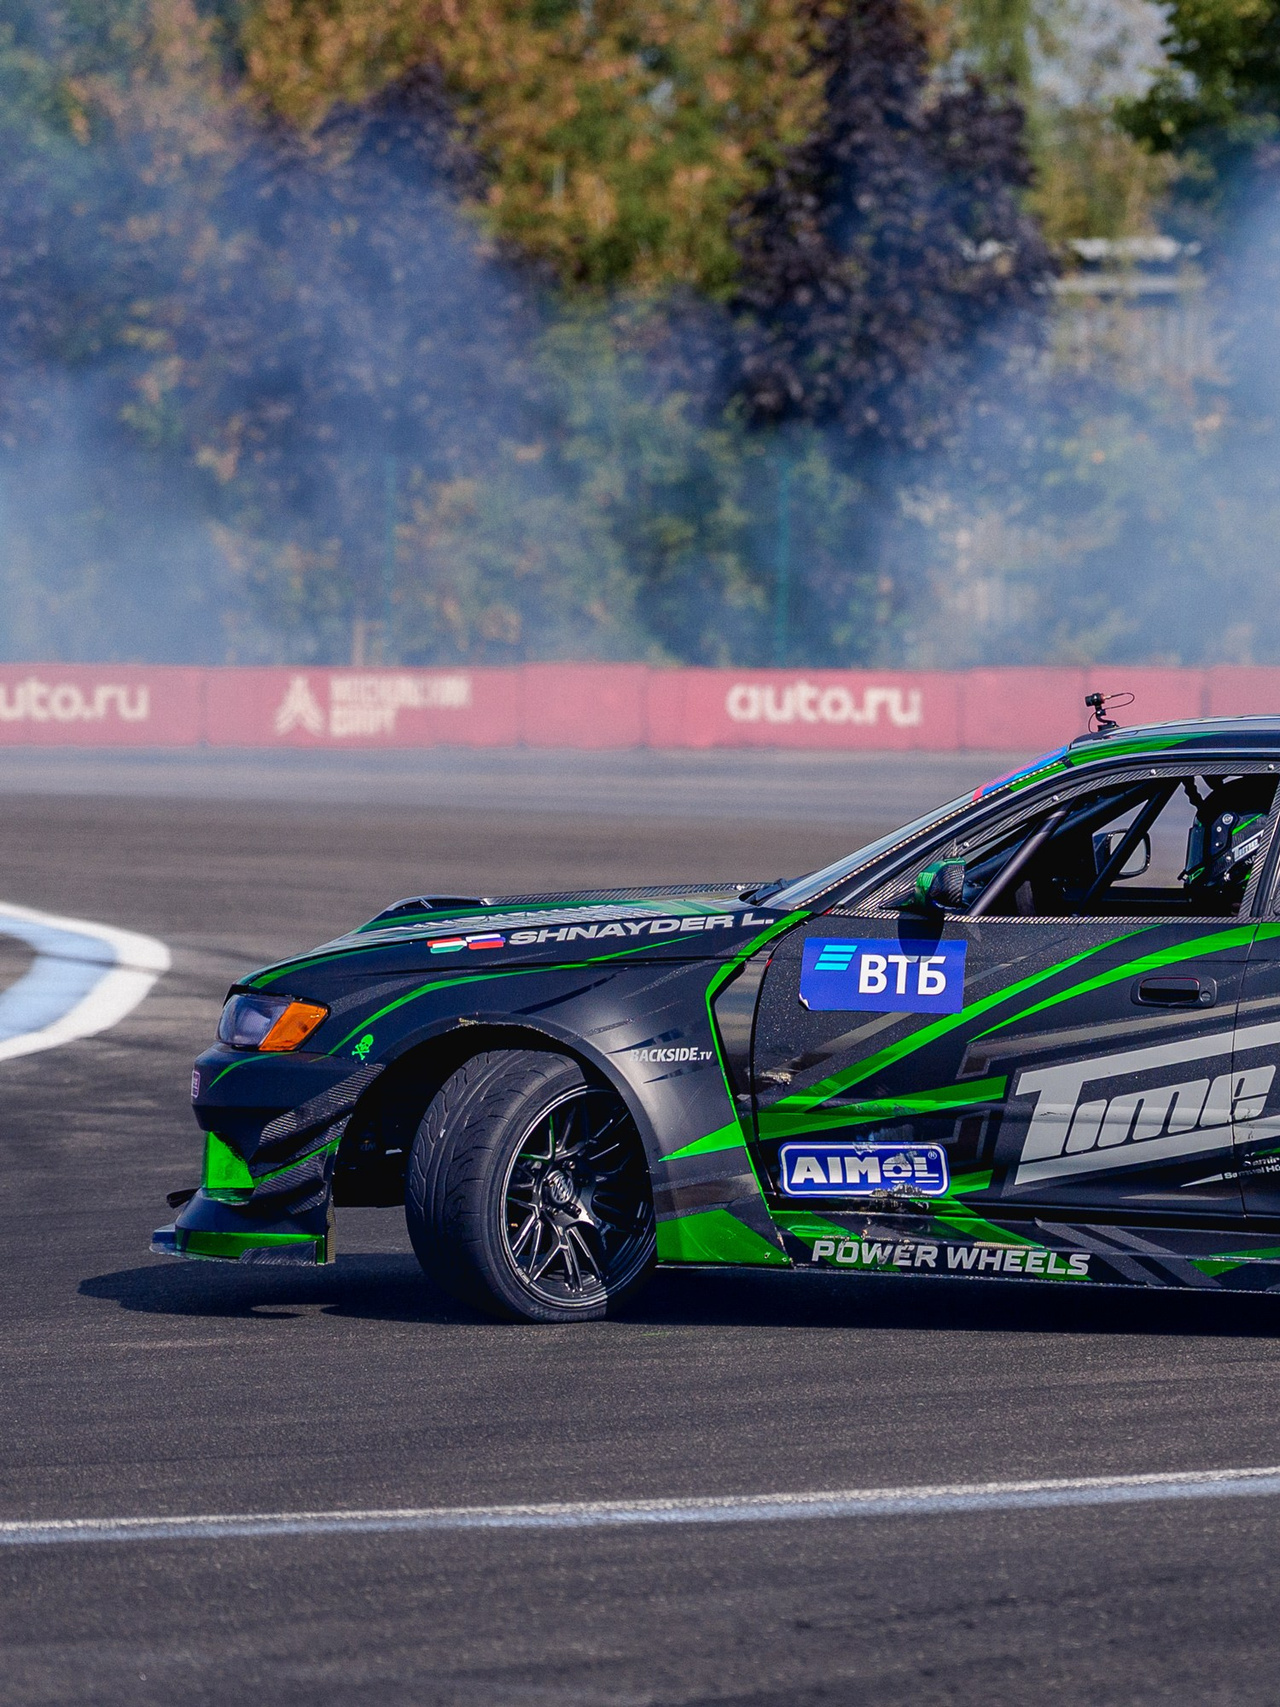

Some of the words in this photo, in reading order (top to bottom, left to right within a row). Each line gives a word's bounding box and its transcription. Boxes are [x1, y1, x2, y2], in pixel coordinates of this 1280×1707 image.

[725, 681, 922, 726] auto.ru
[509, 915, 735, 946] SHNAYDER
[741, 913, 775, 926] L.
[858, 954, 947, 996] ВТБ
[791, 1154, 939, 1184] AIMOL
[811, 1240, 939, 1269] POWER
[946, 1247, 1091, 1276] WHEELS
